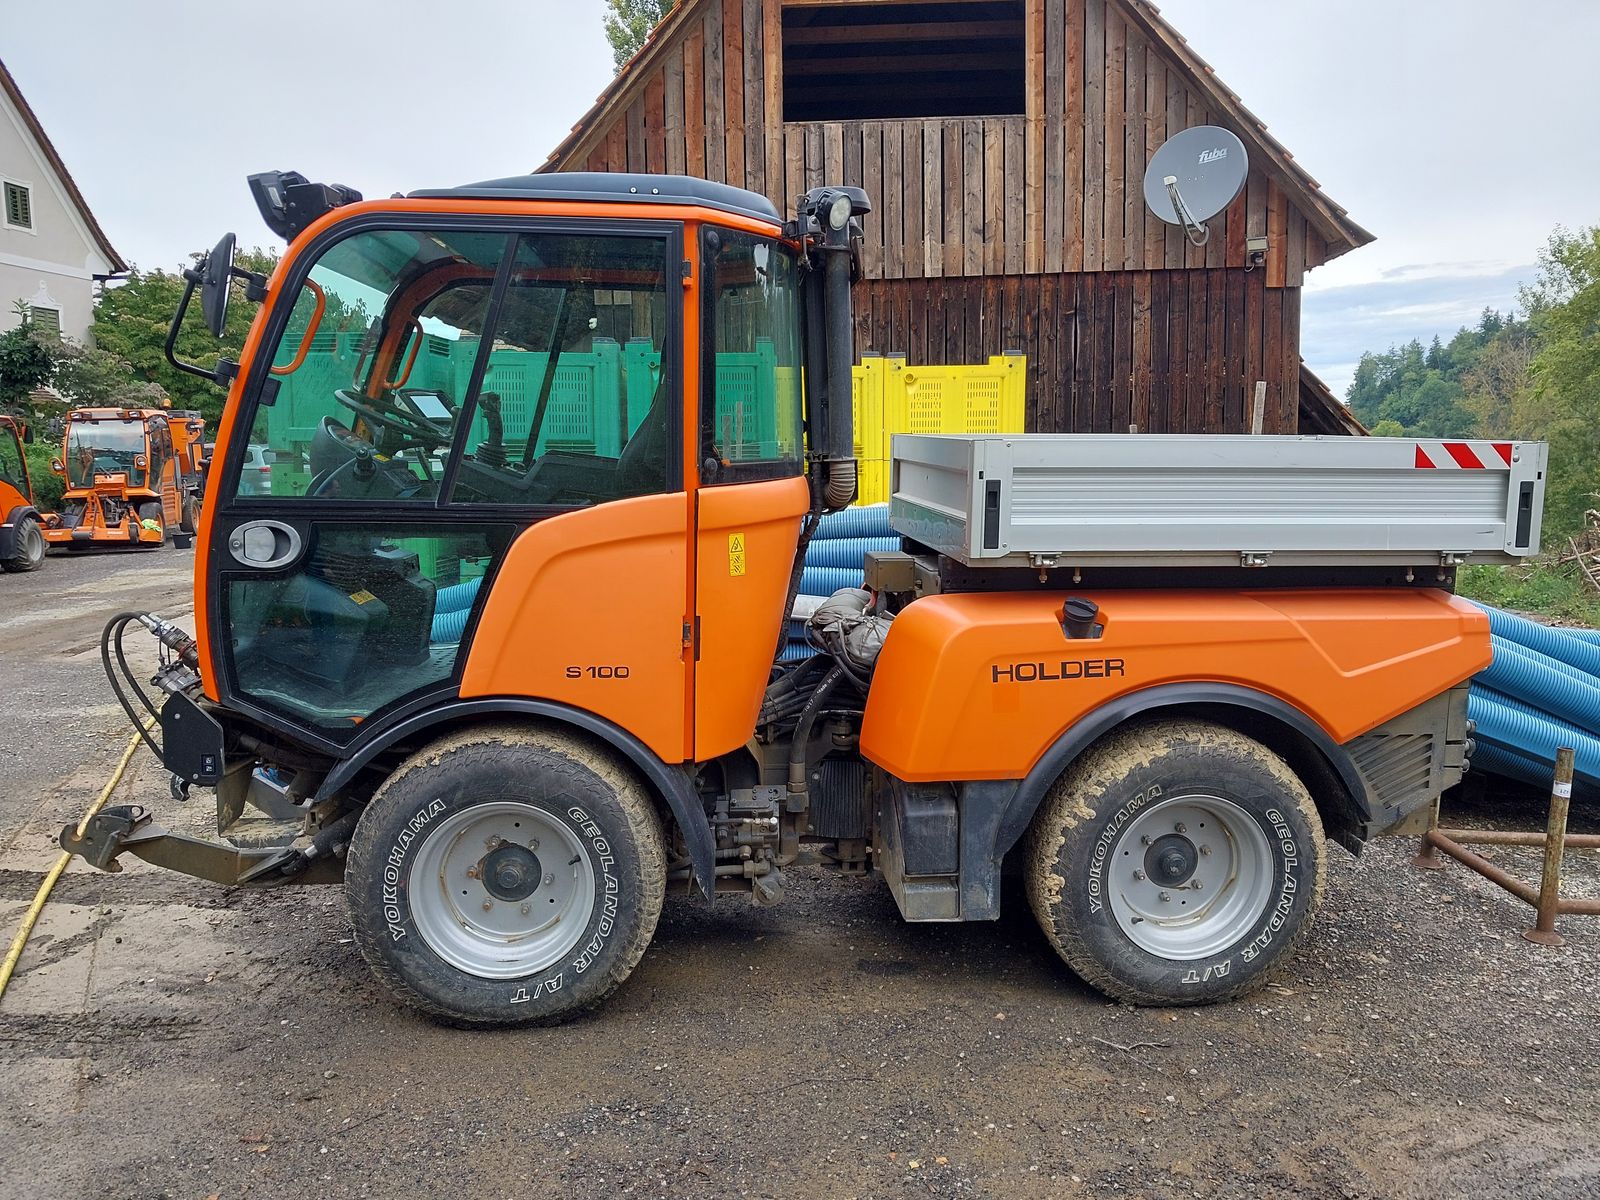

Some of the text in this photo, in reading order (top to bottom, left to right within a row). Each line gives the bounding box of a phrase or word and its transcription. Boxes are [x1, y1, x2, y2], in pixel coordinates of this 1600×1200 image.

[1199, 148, 1227, 163] fuba
[566, 666, 629, 679] S 100
[992, 659, 1125, 683] HOLDER
[383, 798, 446, 942] YOKOHAMA
[510, 806, 618, 1003] GEOLANDAR A/T
[1088, 784, 1163, 914] YOKOHAMA
[1182, 808, 1298, 983] GEOLANDAR A/T
